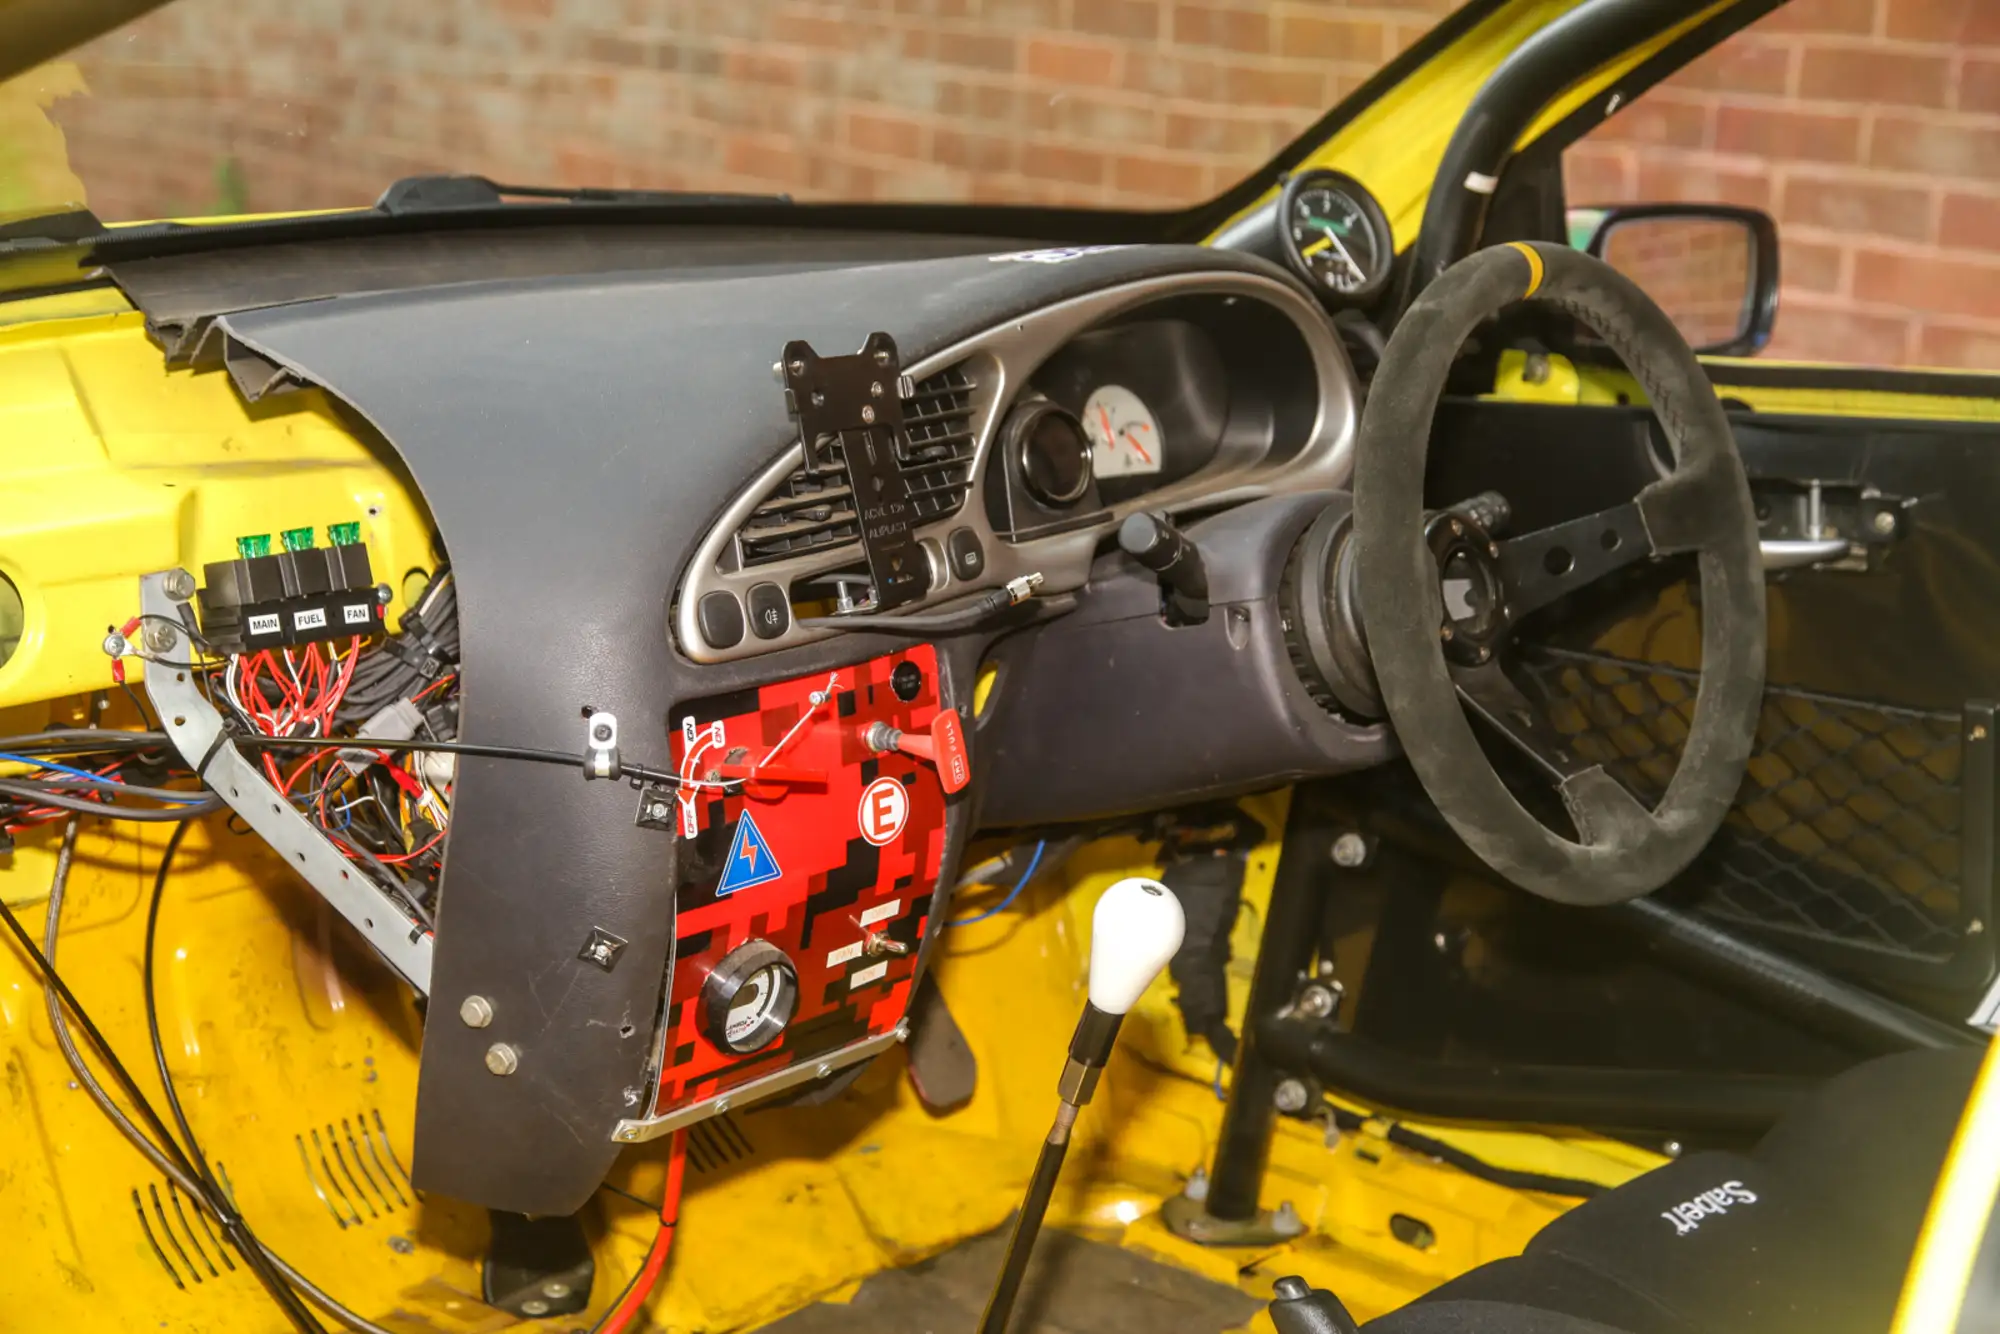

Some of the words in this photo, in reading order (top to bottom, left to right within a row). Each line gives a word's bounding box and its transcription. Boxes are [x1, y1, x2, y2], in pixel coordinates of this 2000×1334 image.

[252, 618, 278, 630] MAIN
[297, 612, 323, 626] FUEL
[346, 608, 367, 619] FAN
[686, 722, 696, 743] IGN
[714, 727, 723, 743] ON
[945, 718, 958, 752] PULL
[686, 809, 695, 834] OFF
[872, 787, 896, 836] E
[1660, 1180, 1758, 1236] Sabelt
